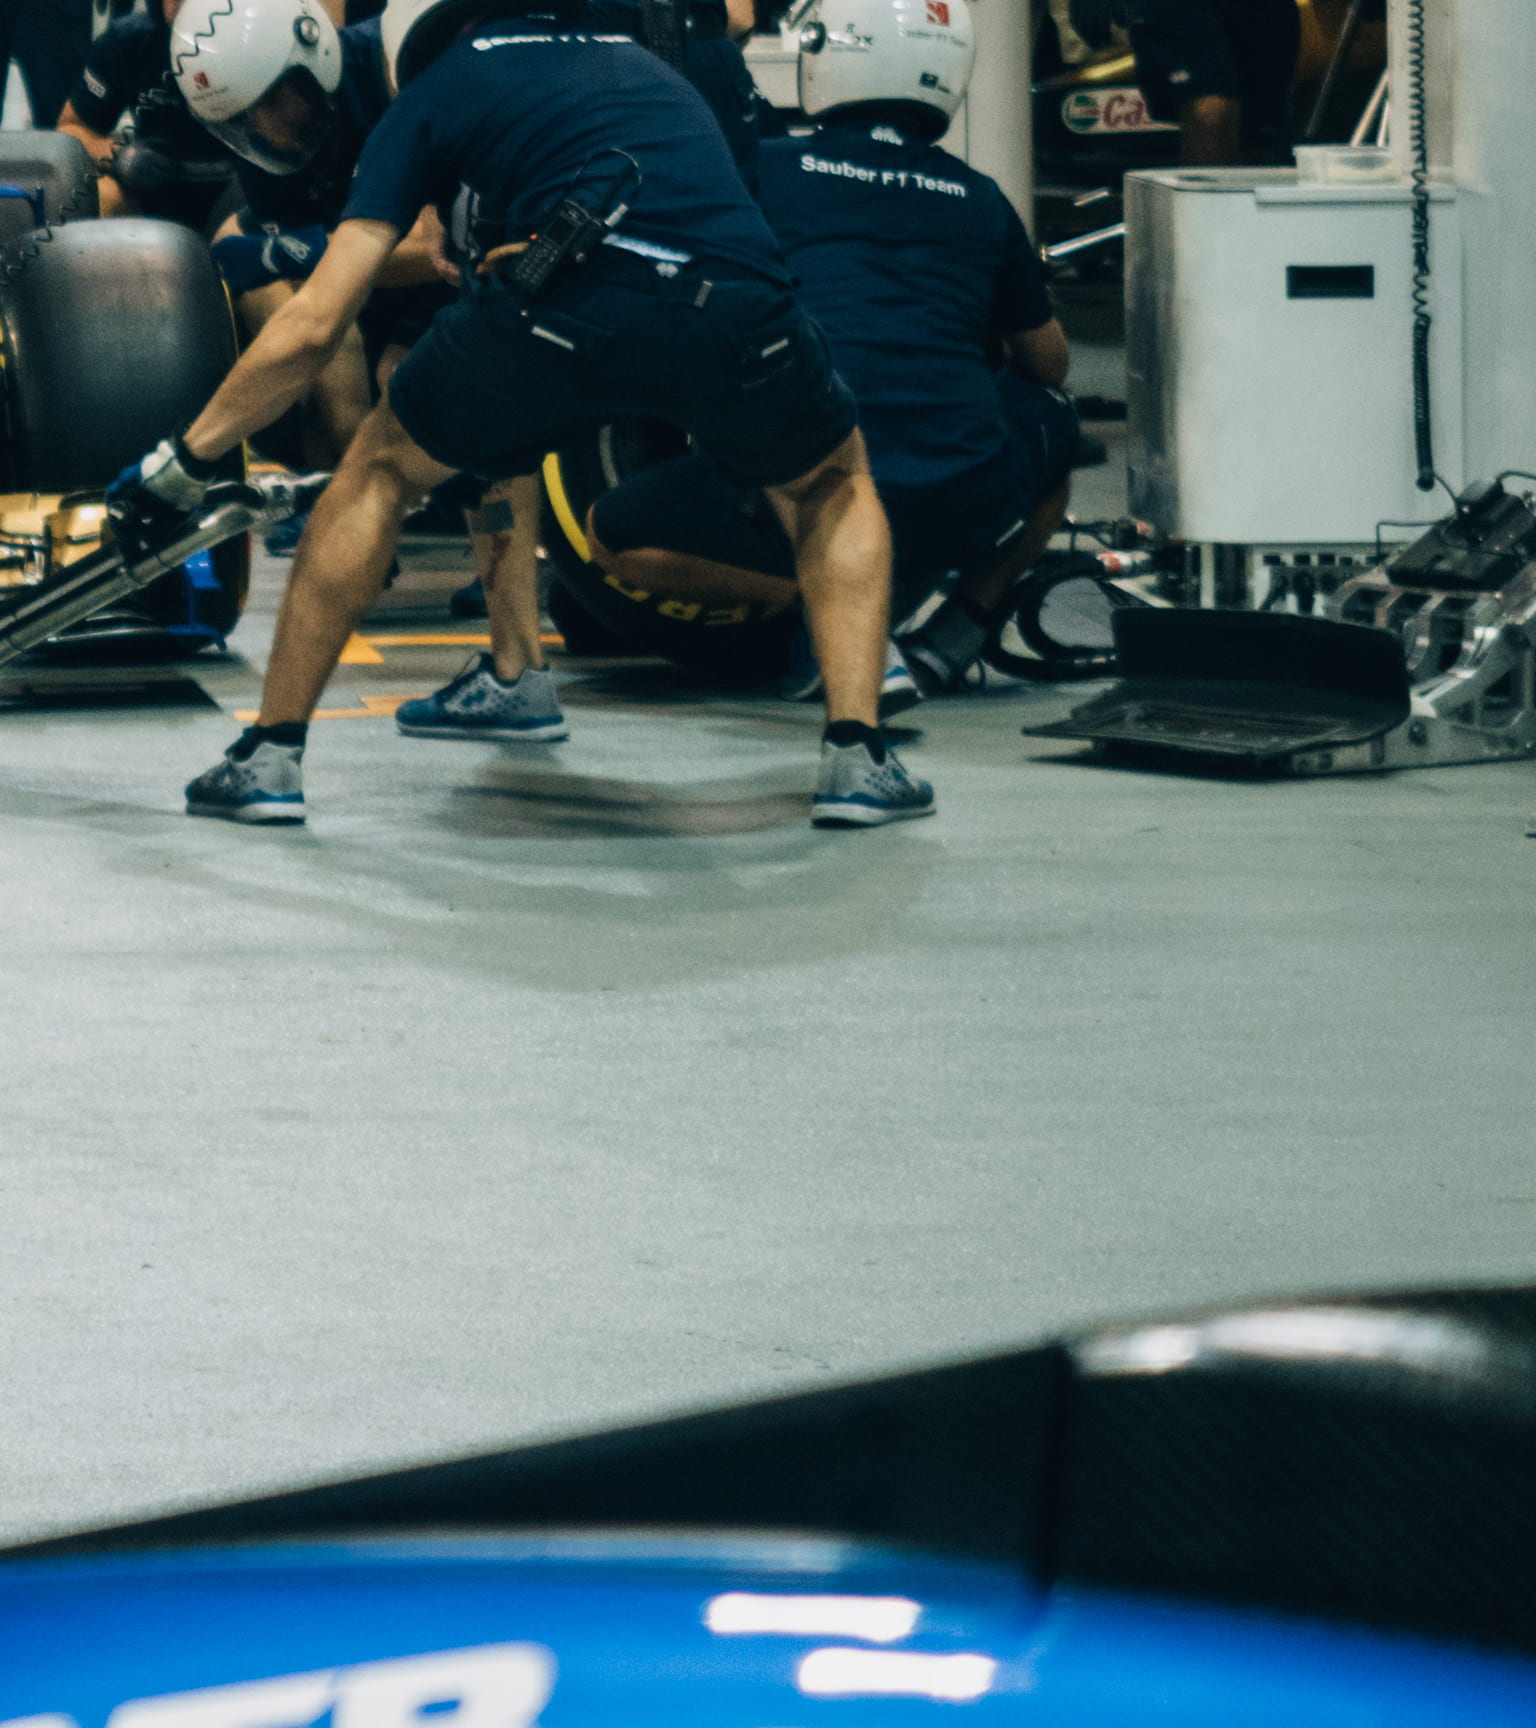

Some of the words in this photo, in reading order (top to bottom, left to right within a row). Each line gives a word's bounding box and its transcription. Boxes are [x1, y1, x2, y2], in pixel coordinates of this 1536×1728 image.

[801, 154, 878, 183] Sauber
[881, 170, 907, 188] F1
[913, 174, 967, 198] Team
